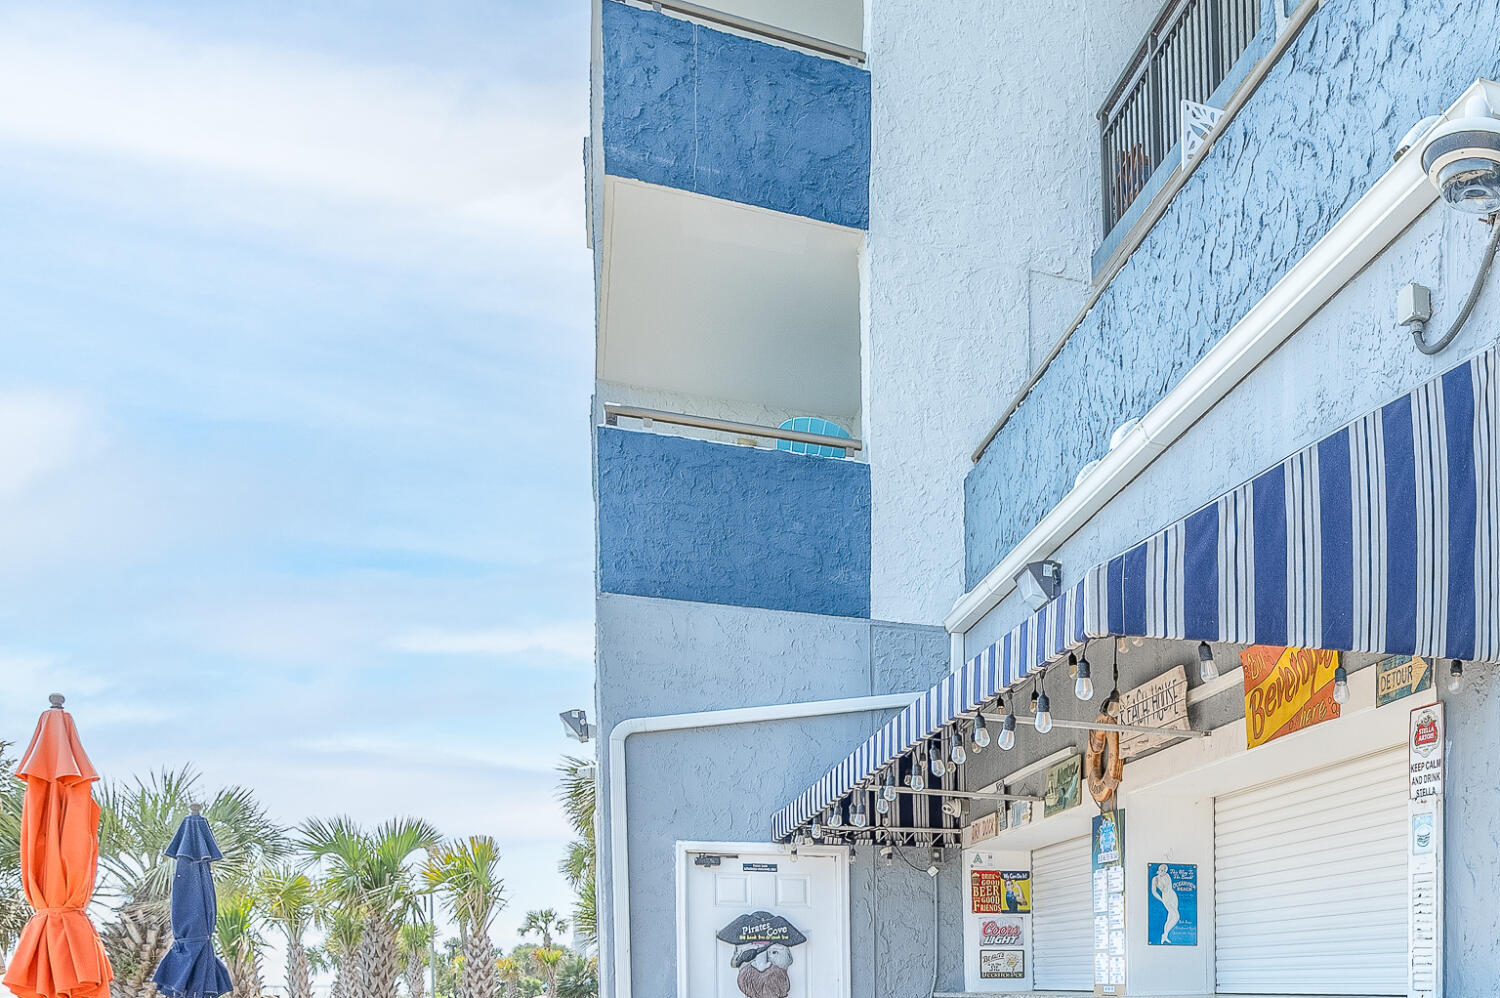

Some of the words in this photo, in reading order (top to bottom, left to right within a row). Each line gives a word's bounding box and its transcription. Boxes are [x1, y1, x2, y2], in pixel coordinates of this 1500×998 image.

[1380, 664, 1412, 692] DETOUR
[1411, 762, 1424, 773] KEEP
[1425, 758, 1441, 770] CALM
[1411, 774, 1422, 786] AND
[1423, 771, 1441, 784] DRINK
[1416, 786, 1436, 798] STELLA
[980, 879, 1000, 887] GOOD
[973, 885, 1000, 897] BEER
[973, 900, 1001, 912] FRIENDS
[980, 896, 1000, 905] GOOD
[742, 922, 770, 935] Pirates
[766, 926, 788, 936] Cove
[983, 920, 1021, 937] Coors
[984, 935, 1019, 945] LIGHT
